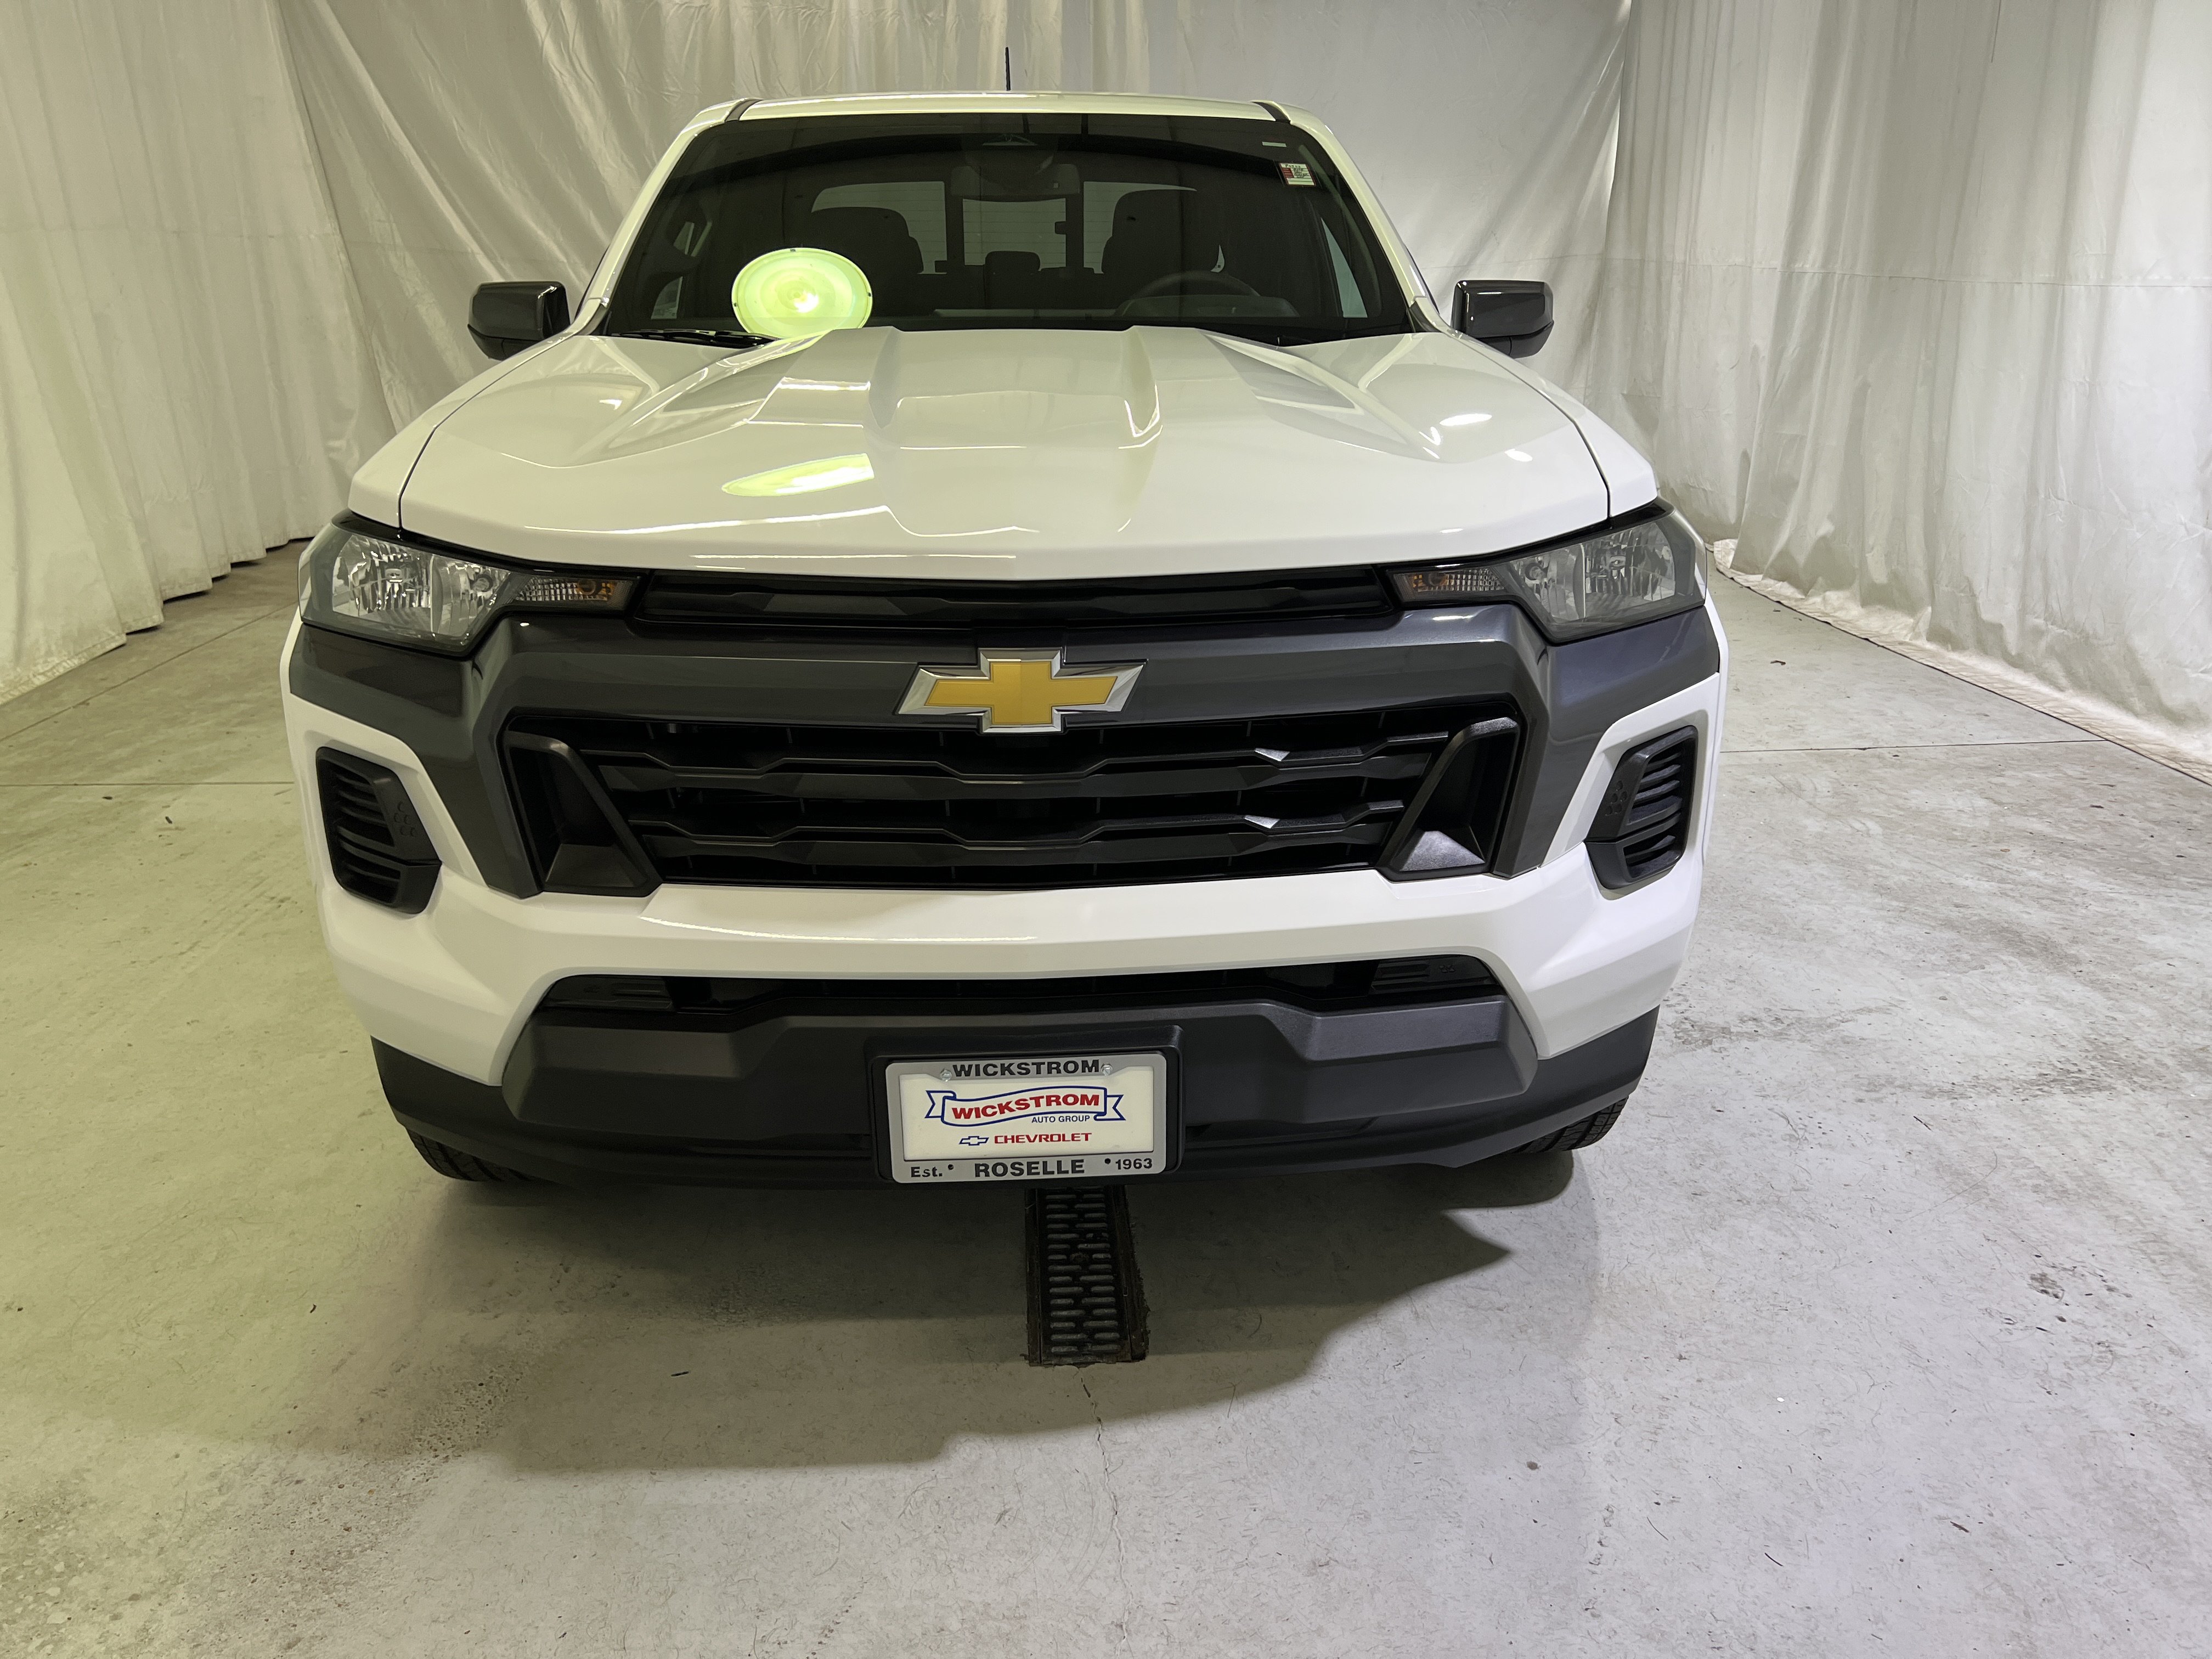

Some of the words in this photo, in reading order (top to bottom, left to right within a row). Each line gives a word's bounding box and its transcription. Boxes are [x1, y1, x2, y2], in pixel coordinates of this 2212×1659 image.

[952, 1059, 1099, 1077] WICKSTROM
[952, 1094, 1099, 1119] WICKSTROM
[994, 1133, 1092, 1144] CHEVROLET
[911, 1166, 943, 1177] Est.
[974, 1159, 1085, 1177] ROSELLE
[1115, 1158, 1153, 1170] 1963
